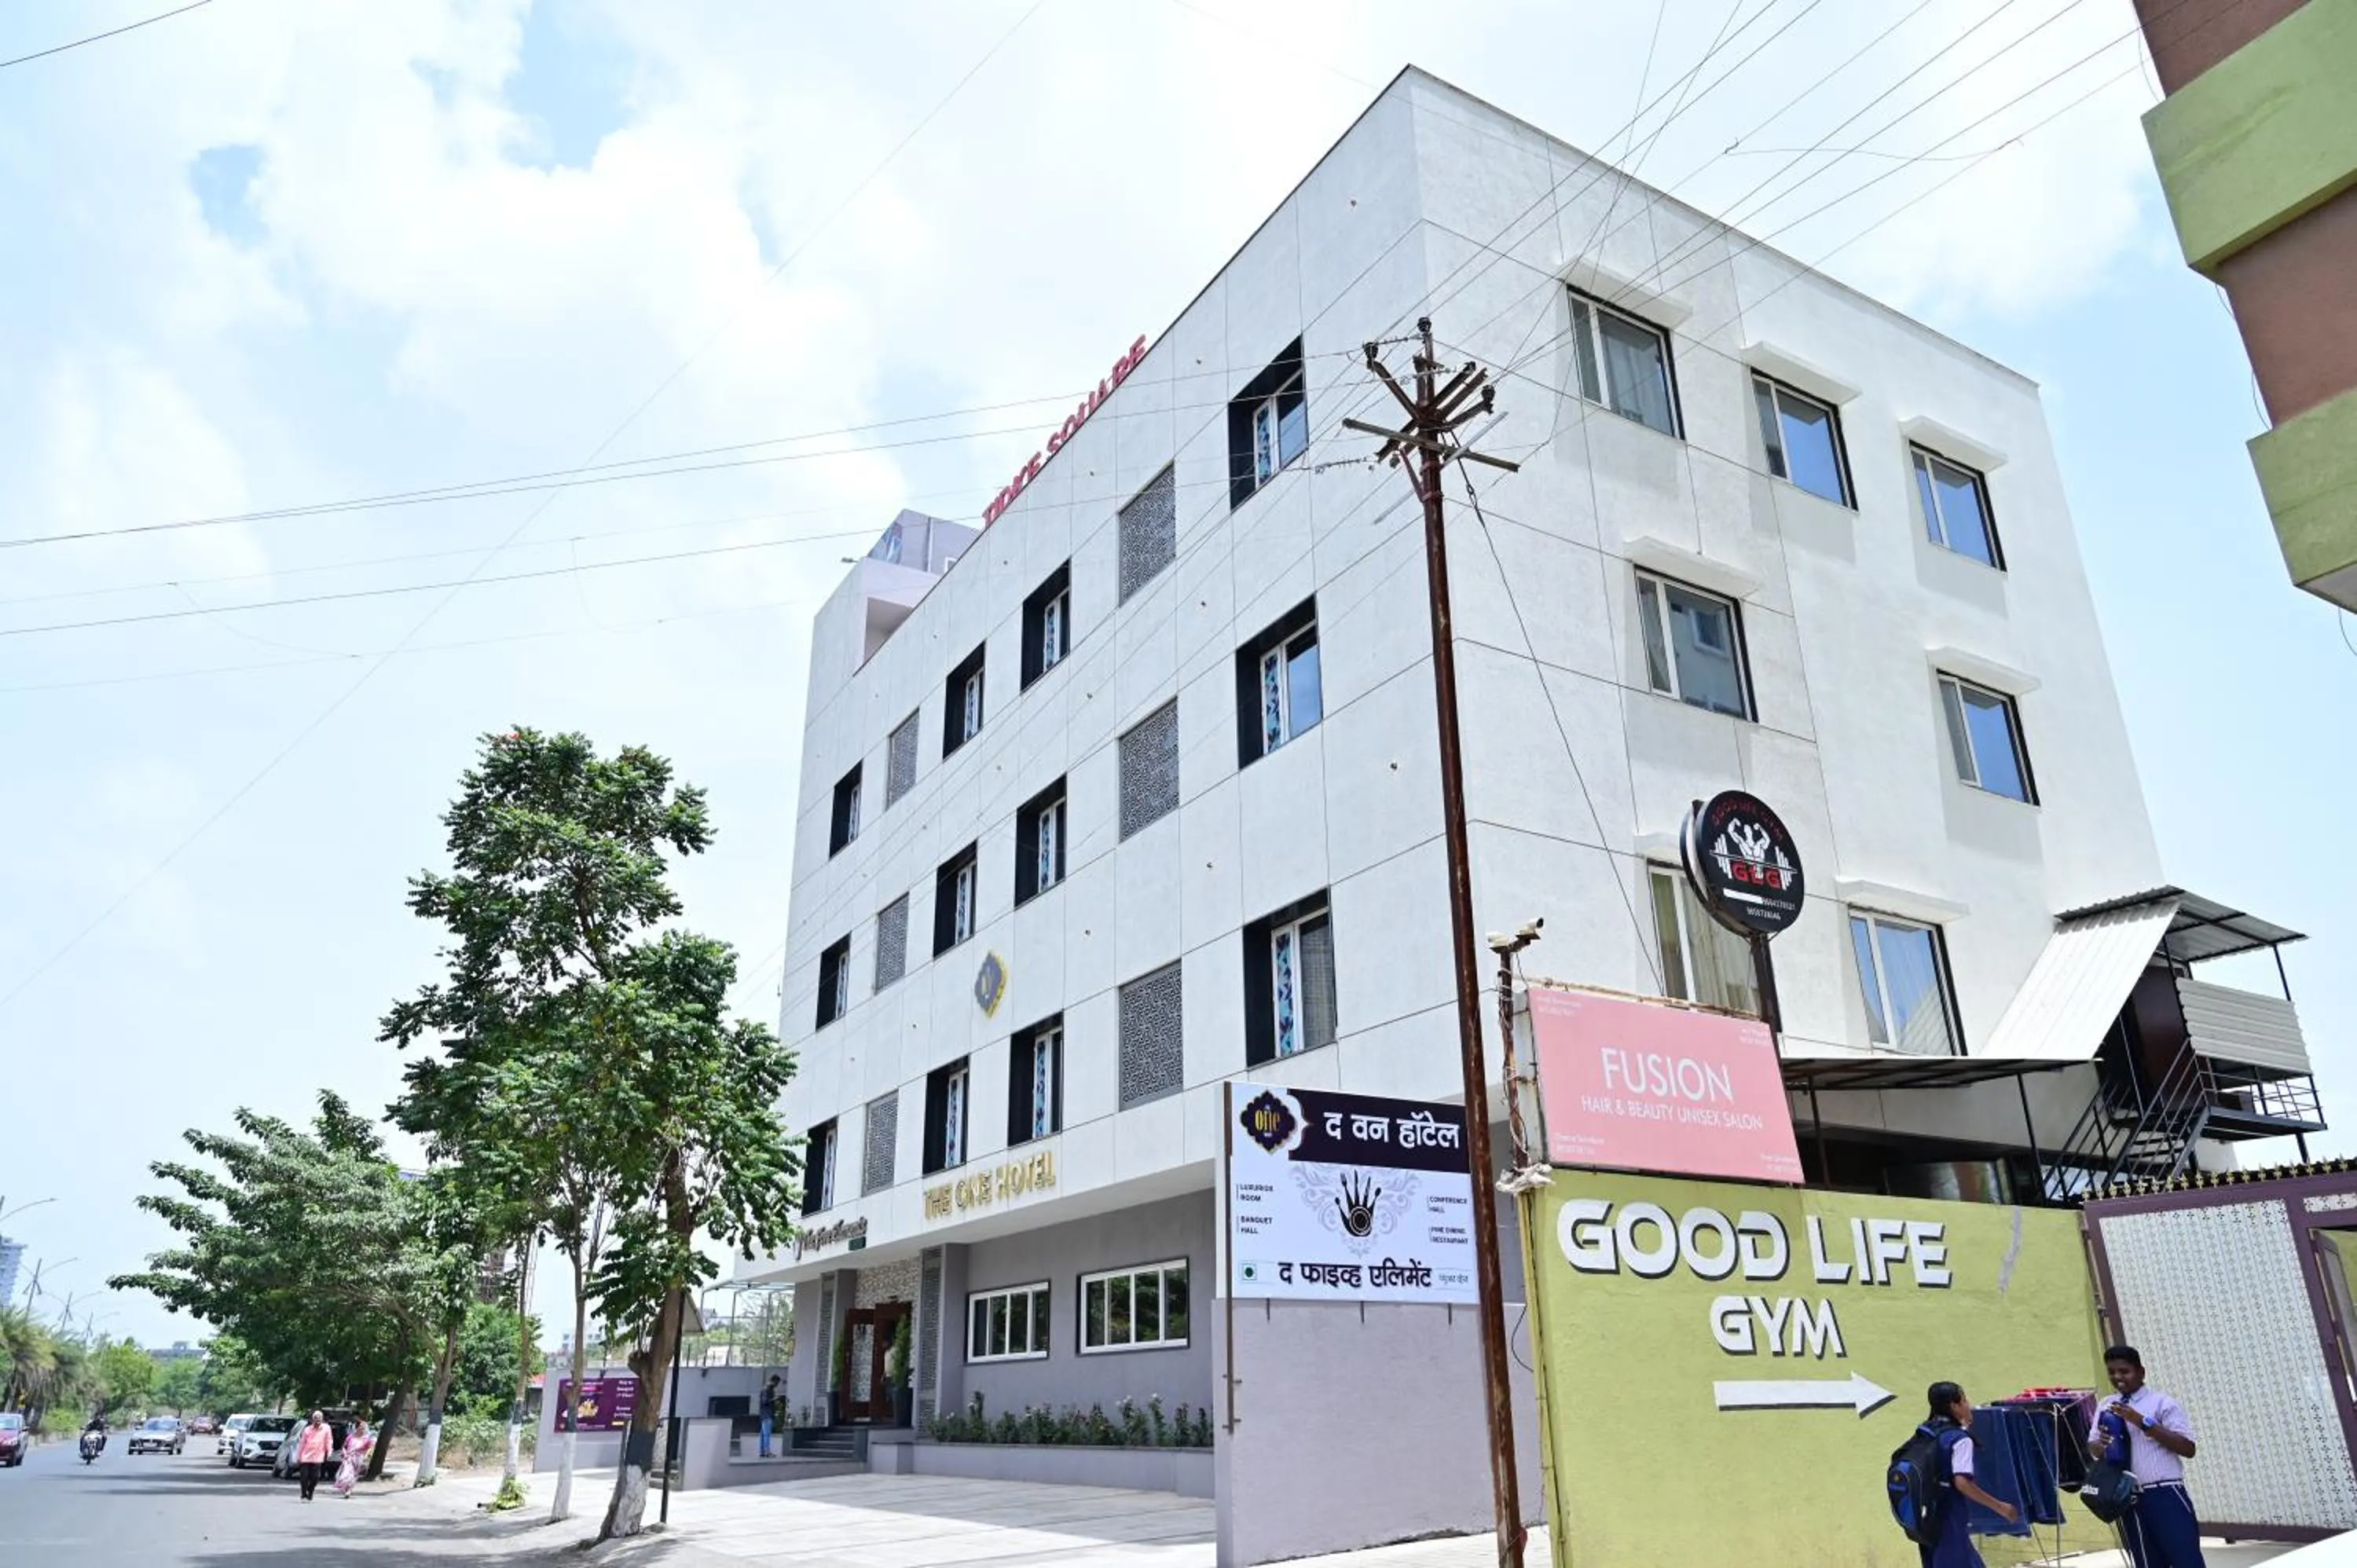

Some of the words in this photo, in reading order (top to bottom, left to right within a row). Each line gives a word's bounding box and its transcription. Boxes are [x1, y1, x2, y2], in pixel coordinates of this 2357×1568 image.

[1601, 1047, 1733, 1104] FUSION
[1324, 1112, 1343, 1140] द
[1351, 1114, 1389, 1142] वन
[1396, 1110, 1460, 1149] हॉटेल
[1582, 1095, 1612, 1116] HAIR
[1615, 1099, 1624, 1116] &
[1628, 1101, 1673, 1121] BEAUTY
[1677, 1108, 1720, 1126] UNISEX
[1722, 1113, 1763, 1130] SALON
[924, 1183, 952, 1221] THE
[955, 1170, 992, 1211] ONE
[996, 1151, 1056, 1202] HOTEL
[1277, 1262, 1293, 1284] द
[1299, 1262, 1362, 1288] फाइव्ह
[1368, 1257, 1432, 1288] एलिमेंट
[1557, 1199, 1791, 1281] GOOD
[1806, 1215, 1953, 1289] LIFE
[1709, 1295, 1848, 1360] GYM
